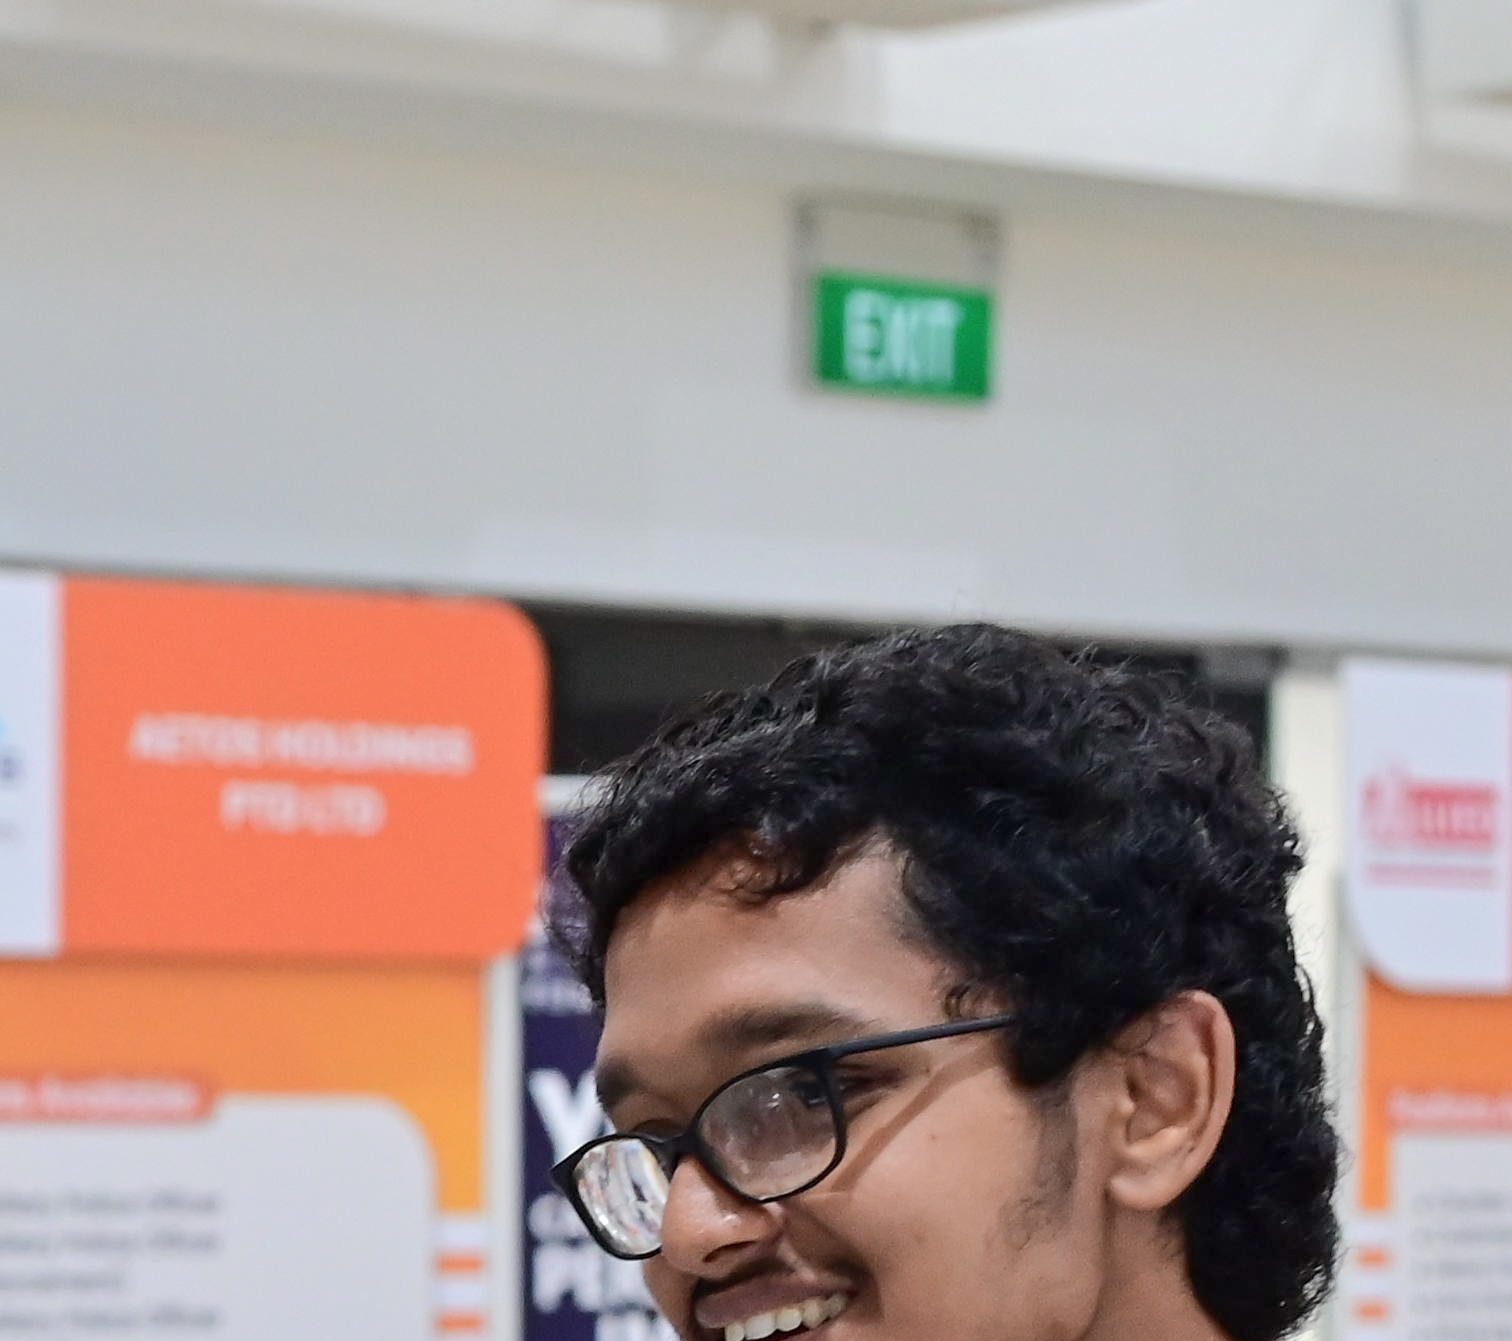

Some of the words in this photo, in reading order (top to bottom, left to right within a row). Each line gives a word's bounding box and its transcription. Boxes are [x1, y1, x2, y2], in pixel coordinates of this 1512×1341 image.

[844, 290, 963, 382] EXIT
[130, 714, 262, 766] AETOS
[272, 722, 474, 776] HOLDINGS
